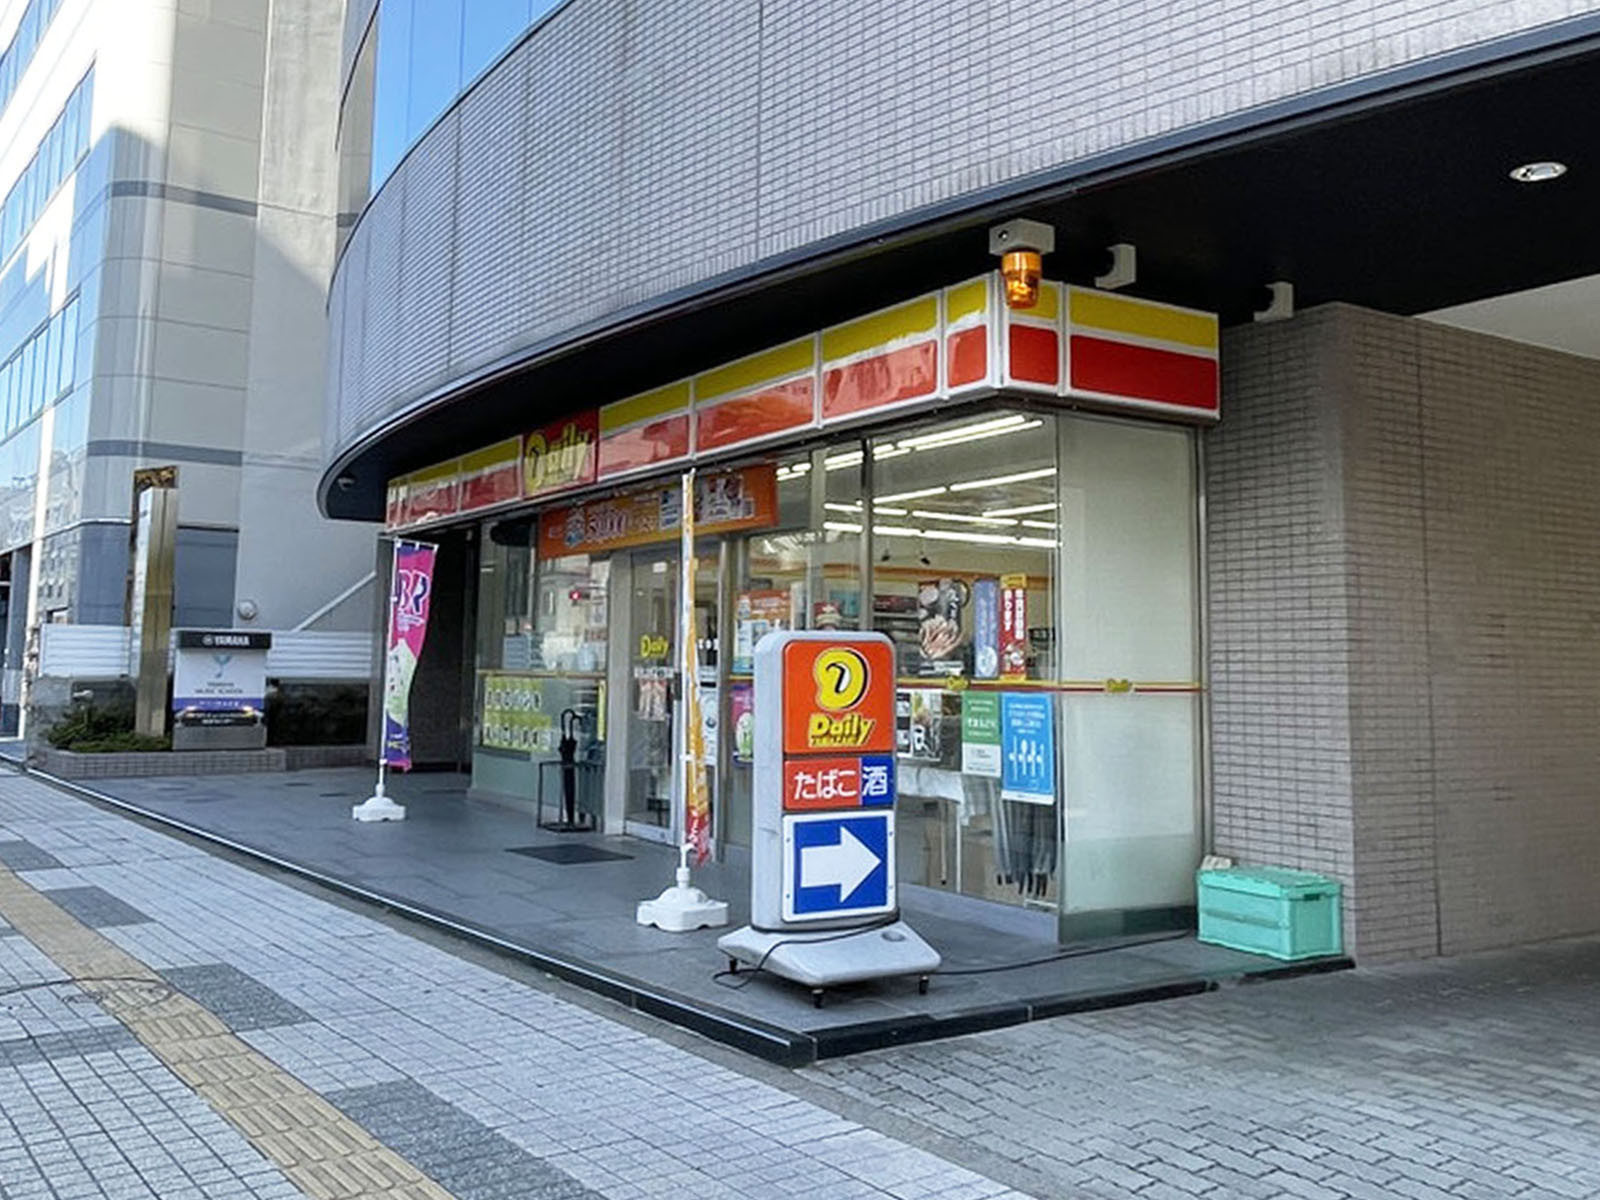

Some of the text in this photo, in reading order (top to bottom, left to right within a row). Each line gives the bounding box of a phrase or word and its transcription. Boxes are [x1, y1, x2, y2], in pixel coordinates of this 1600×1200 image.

[524, 424, 590, 494] Daily
[215, 636, 250, 646] YAMAHA
[640, 634, 668, 657] Daily
[809, 712, 875, 746] Daily
[794, 769, 857, 800] たばこ
[862, 766, 888, 796] 酒
